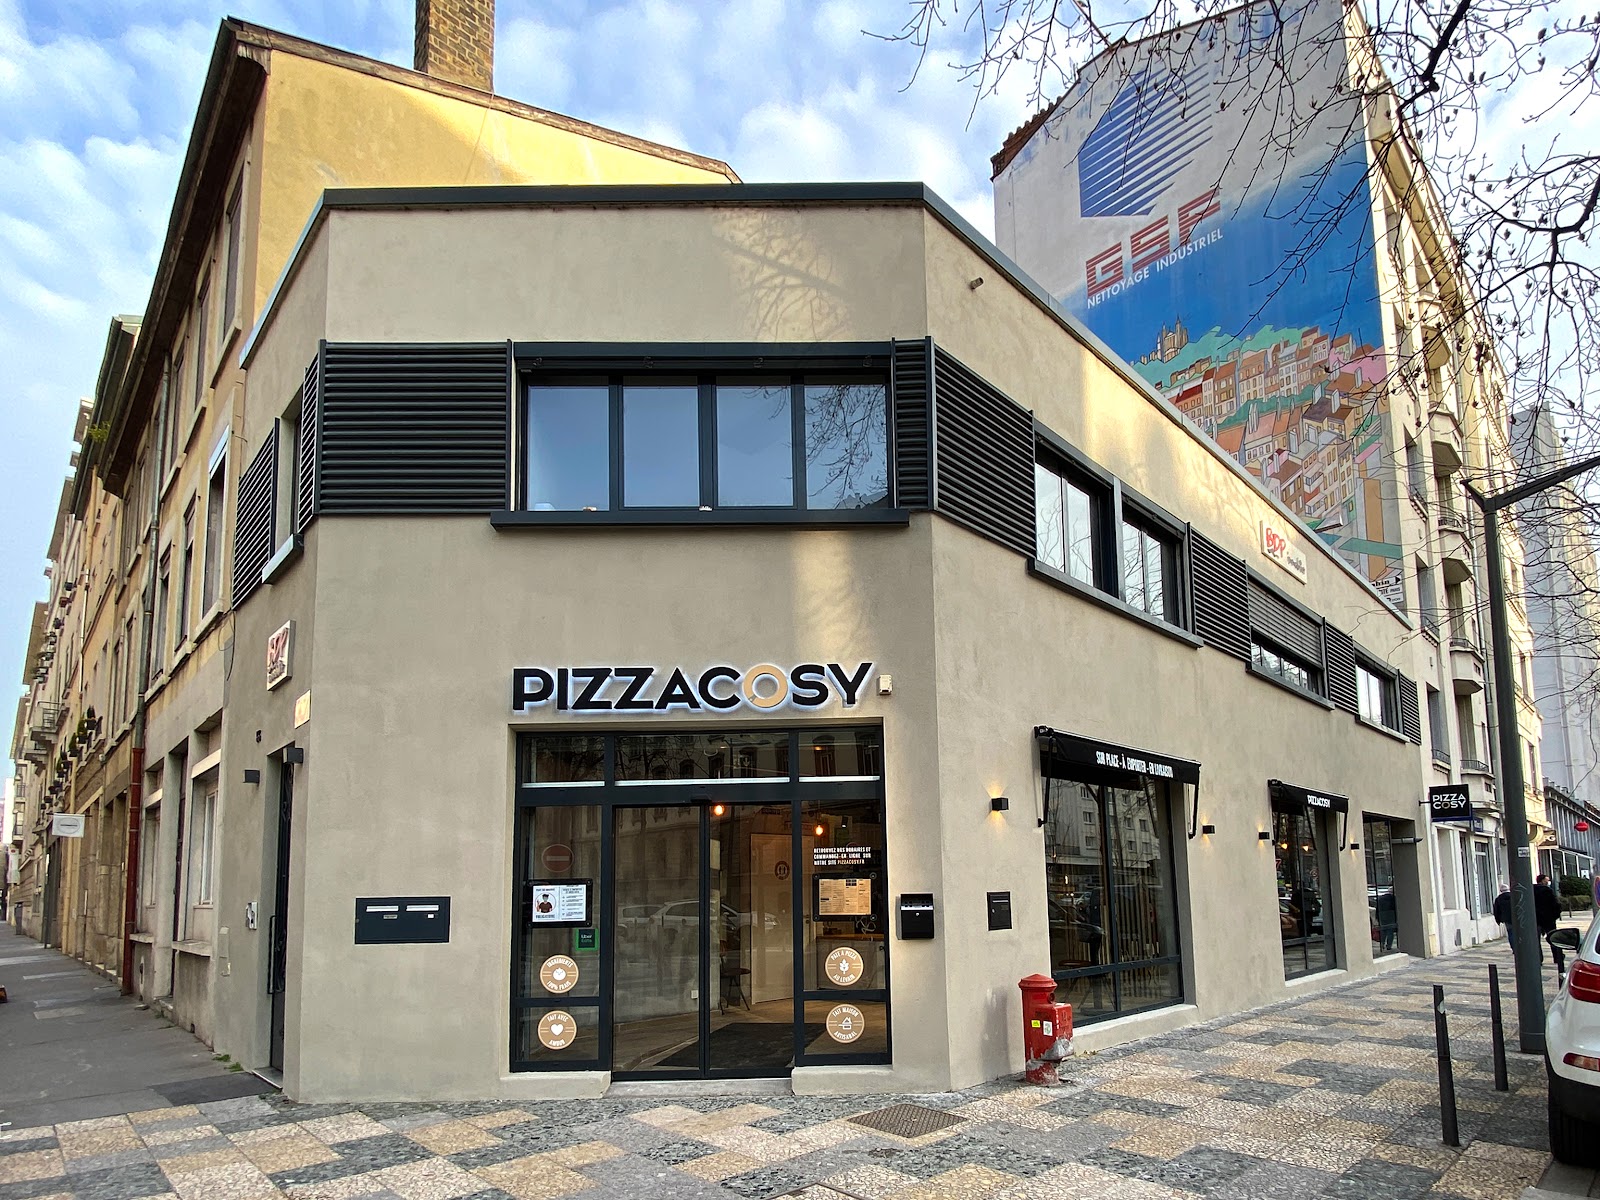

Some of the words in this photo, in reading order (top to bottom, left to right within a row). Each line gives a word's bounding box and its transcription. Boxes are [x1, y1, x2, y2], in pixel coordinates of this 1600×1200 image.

[1085, 188, 1221, 297] GSF
[1087, 267, 1150, 310] NETTOYAGE
[1156, 227, 1224, 272] INDUSTRIEL
[512, 661, 873, 711] PIZZACOSY
[1095, 750, 1106, 765] SUR
[1105, 752, 1120, 768] PLACE
[1126, 757, 1147, 773] EMPORTER
[1148, 761, 1155, 775] EN
[1154, 763, 1174, 779] LIVRAISON
[1432, 793, 1467, 802] PIZZA
[1432, 800, 1467, 810] COSY
